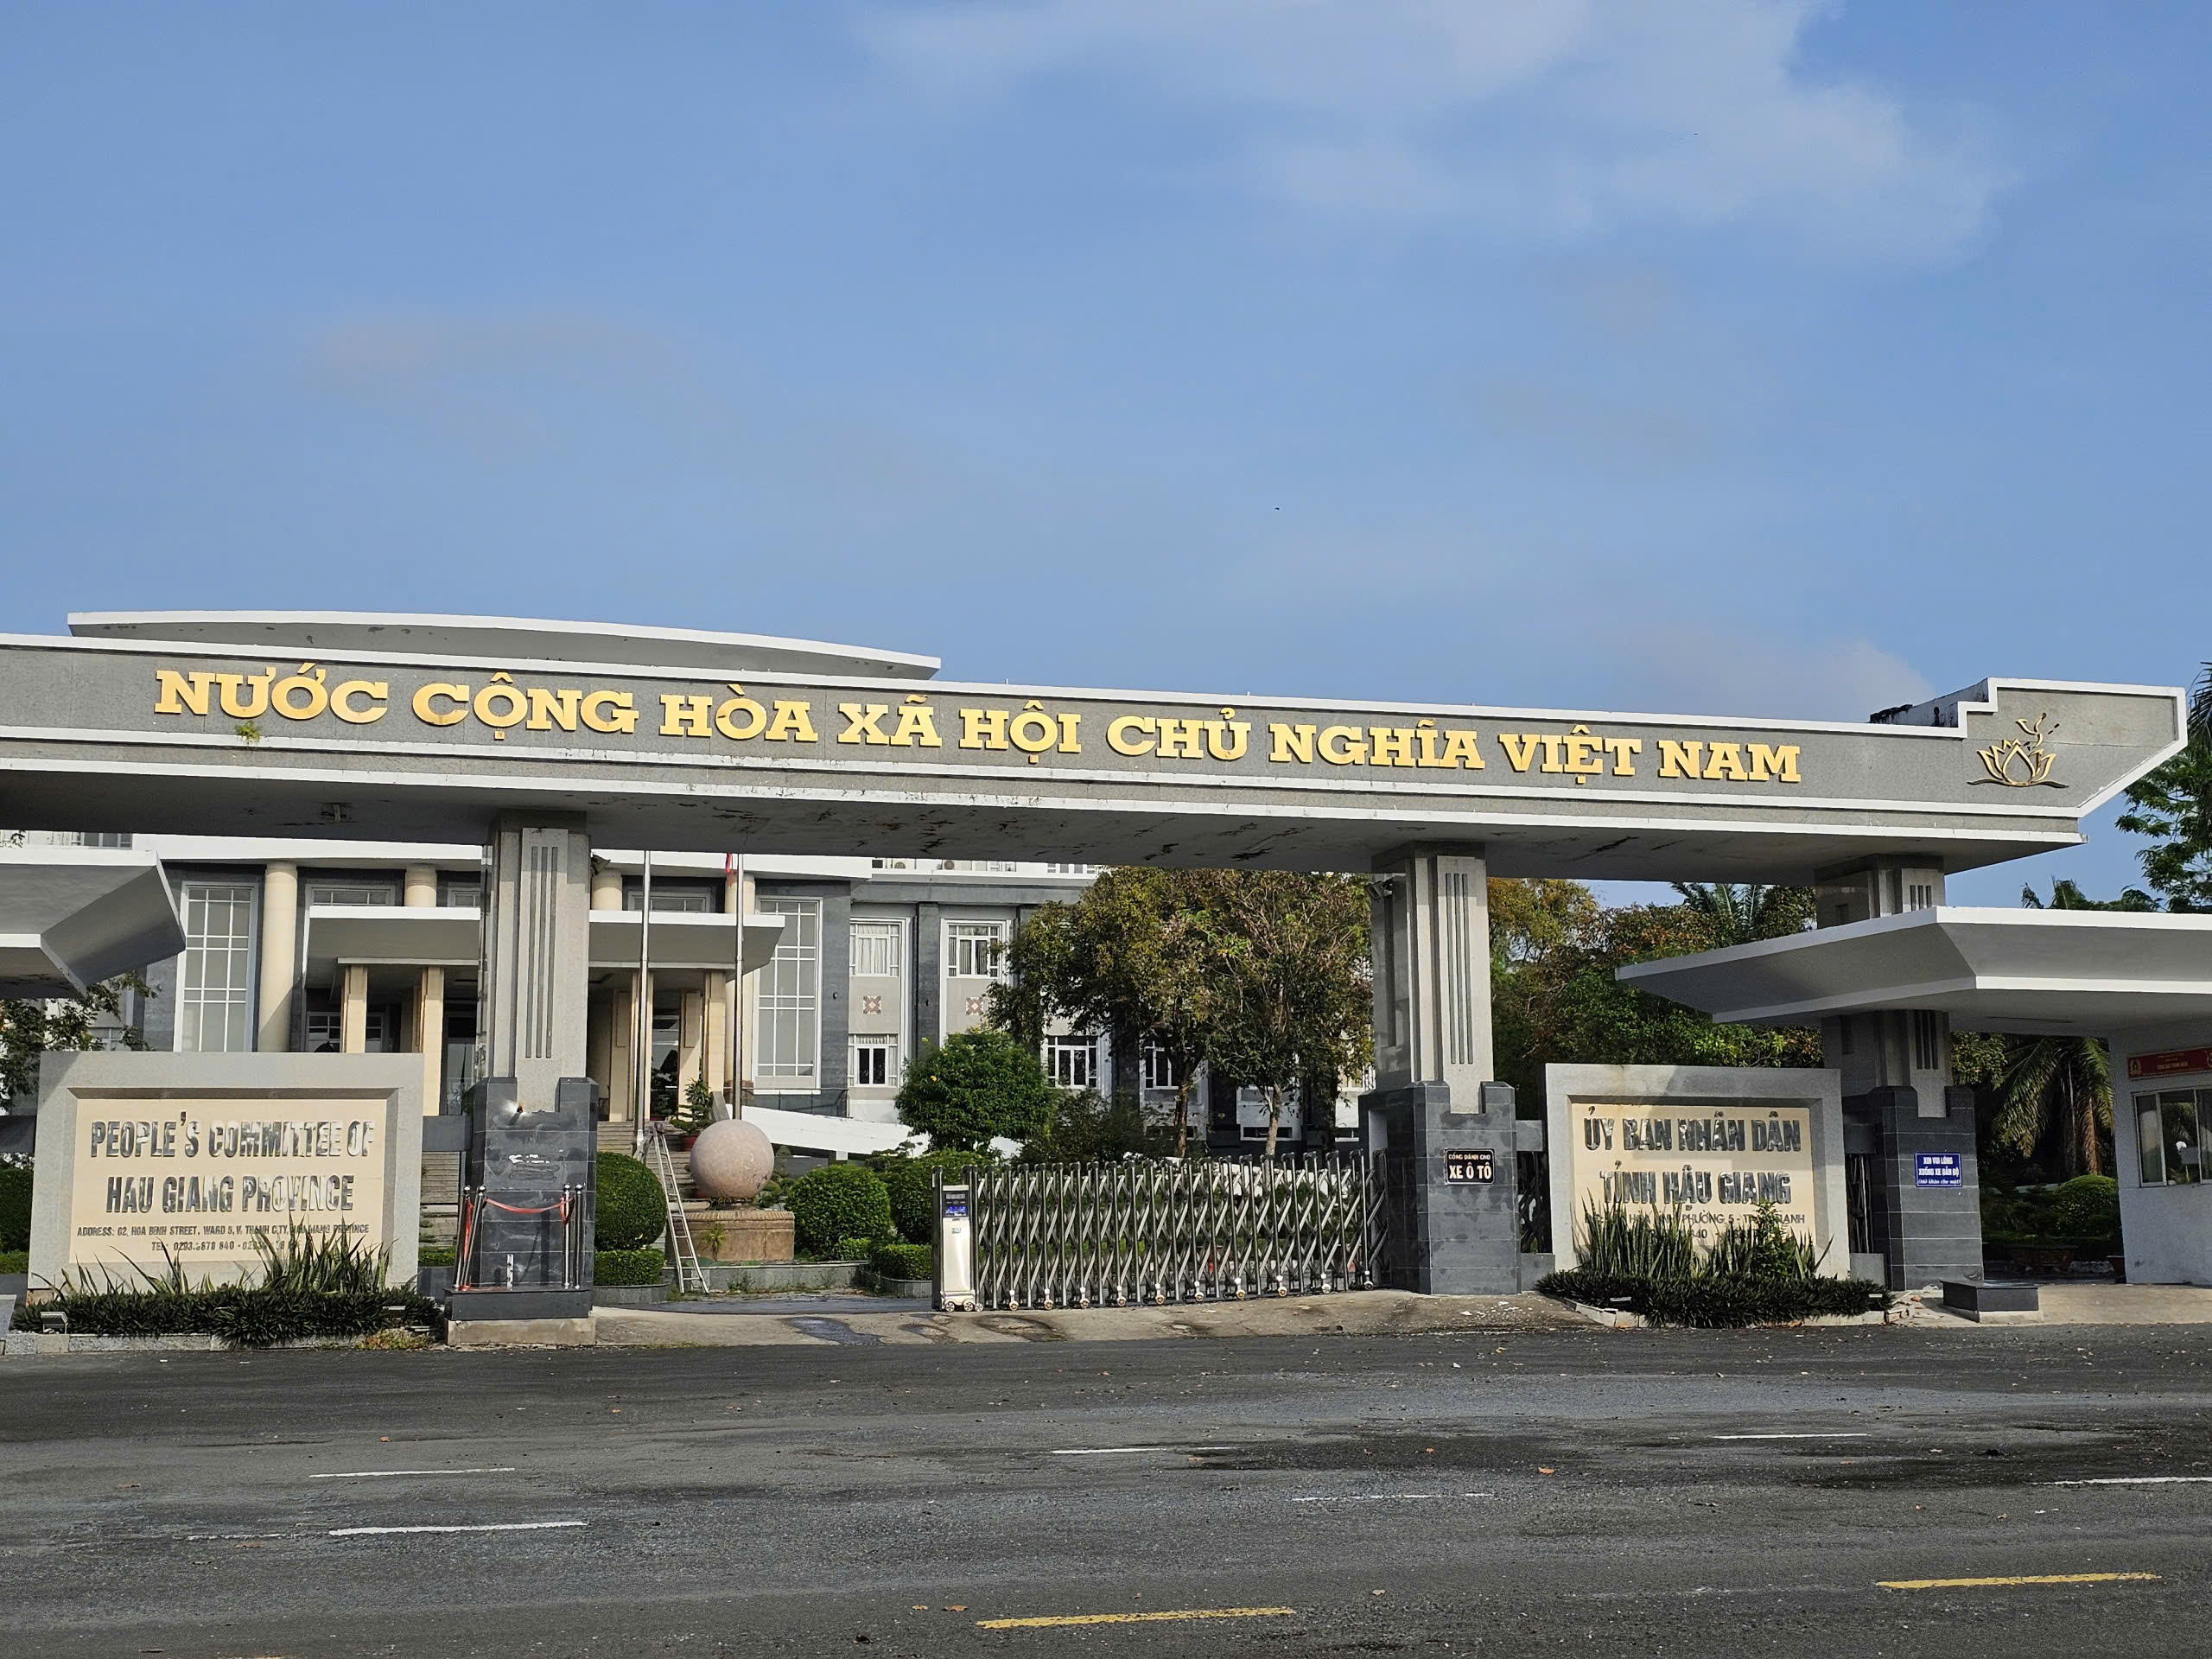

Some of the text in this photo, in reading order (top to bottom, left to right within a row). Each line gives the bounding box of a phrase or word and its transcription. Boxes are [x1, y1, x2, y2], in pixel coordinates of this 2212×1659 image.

[154, 663, 1802, 784] NƯỚC CỘNG HÒA XÃ HỘI CHỦ NGHĨA VIỆT NAM
[91, 1111, 374, 1158] PEOPLE'S COMMITTEE OF
[1584, 1105, 1802, 1153] ỦY BAN NHÂN DÂN
[1449, 1161, 1492, 1179] XE Ô TÔ
[1600, 1160, 1792, 1211] TỈNH HẬU GIANG
[106, 1174, 354, 1213] HAU GIANG PROVINCE
[77, 1226, 115, 1236] ADDRESS:
[131, 1226, 146, 1236] HOA
[203, 1225, 225, 1236] WARD
[334, 1224, 369, 1234] PRINCE
[1729, 1214, 1735, 1224] 5
